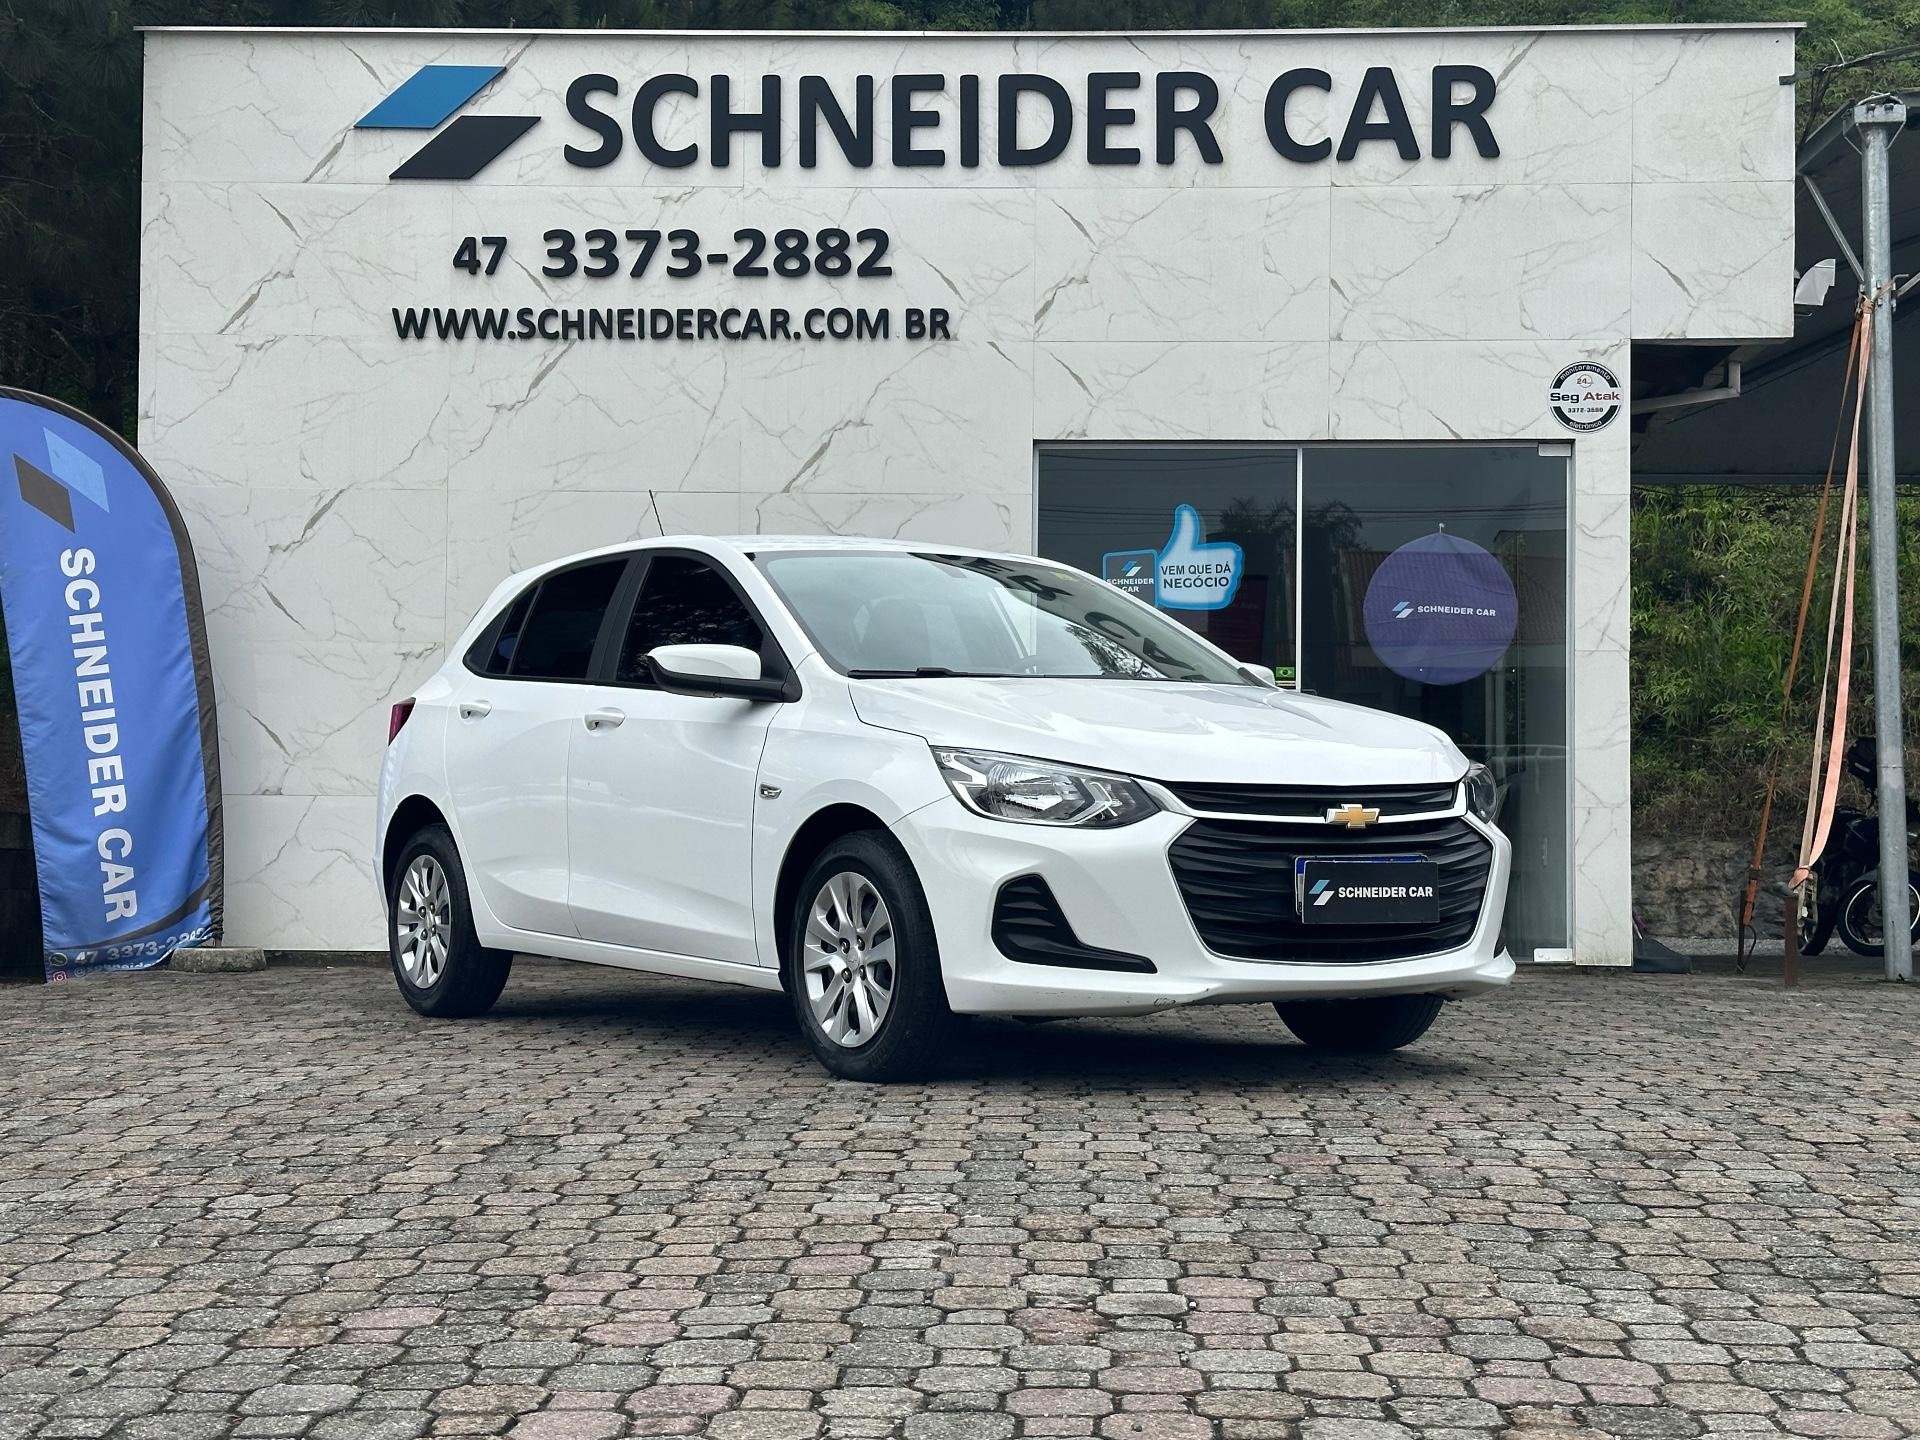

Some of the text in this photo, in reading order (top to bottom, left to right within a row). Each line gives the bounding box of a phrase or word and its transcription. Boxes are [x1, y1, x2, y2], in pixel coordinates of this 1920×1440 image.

[563, 64, 1500, 168] SCHNEIDER CAR
[452, 229, 892, 279] 47 3373-2882
[392, 307, 950, 340] WWW.SCHNEIDERCAR.COM BR
[1560, 364, 1611, 380] monitoramento
[1550, 391, 1620, 403] Seg Atak
[1161, 561, 1231, 576] VEM QUE DÁ
[1163, 575, 1230, 589] NEGÓCIO
[1417, 605, 1496, 617] SCHNEIDER CAR
[60, 548, 138, 923] SCHNEIDER CAR
[1338, 886, 1433, 898] SCHNEIDER CAR
[75, 951, 98, 964] 47
